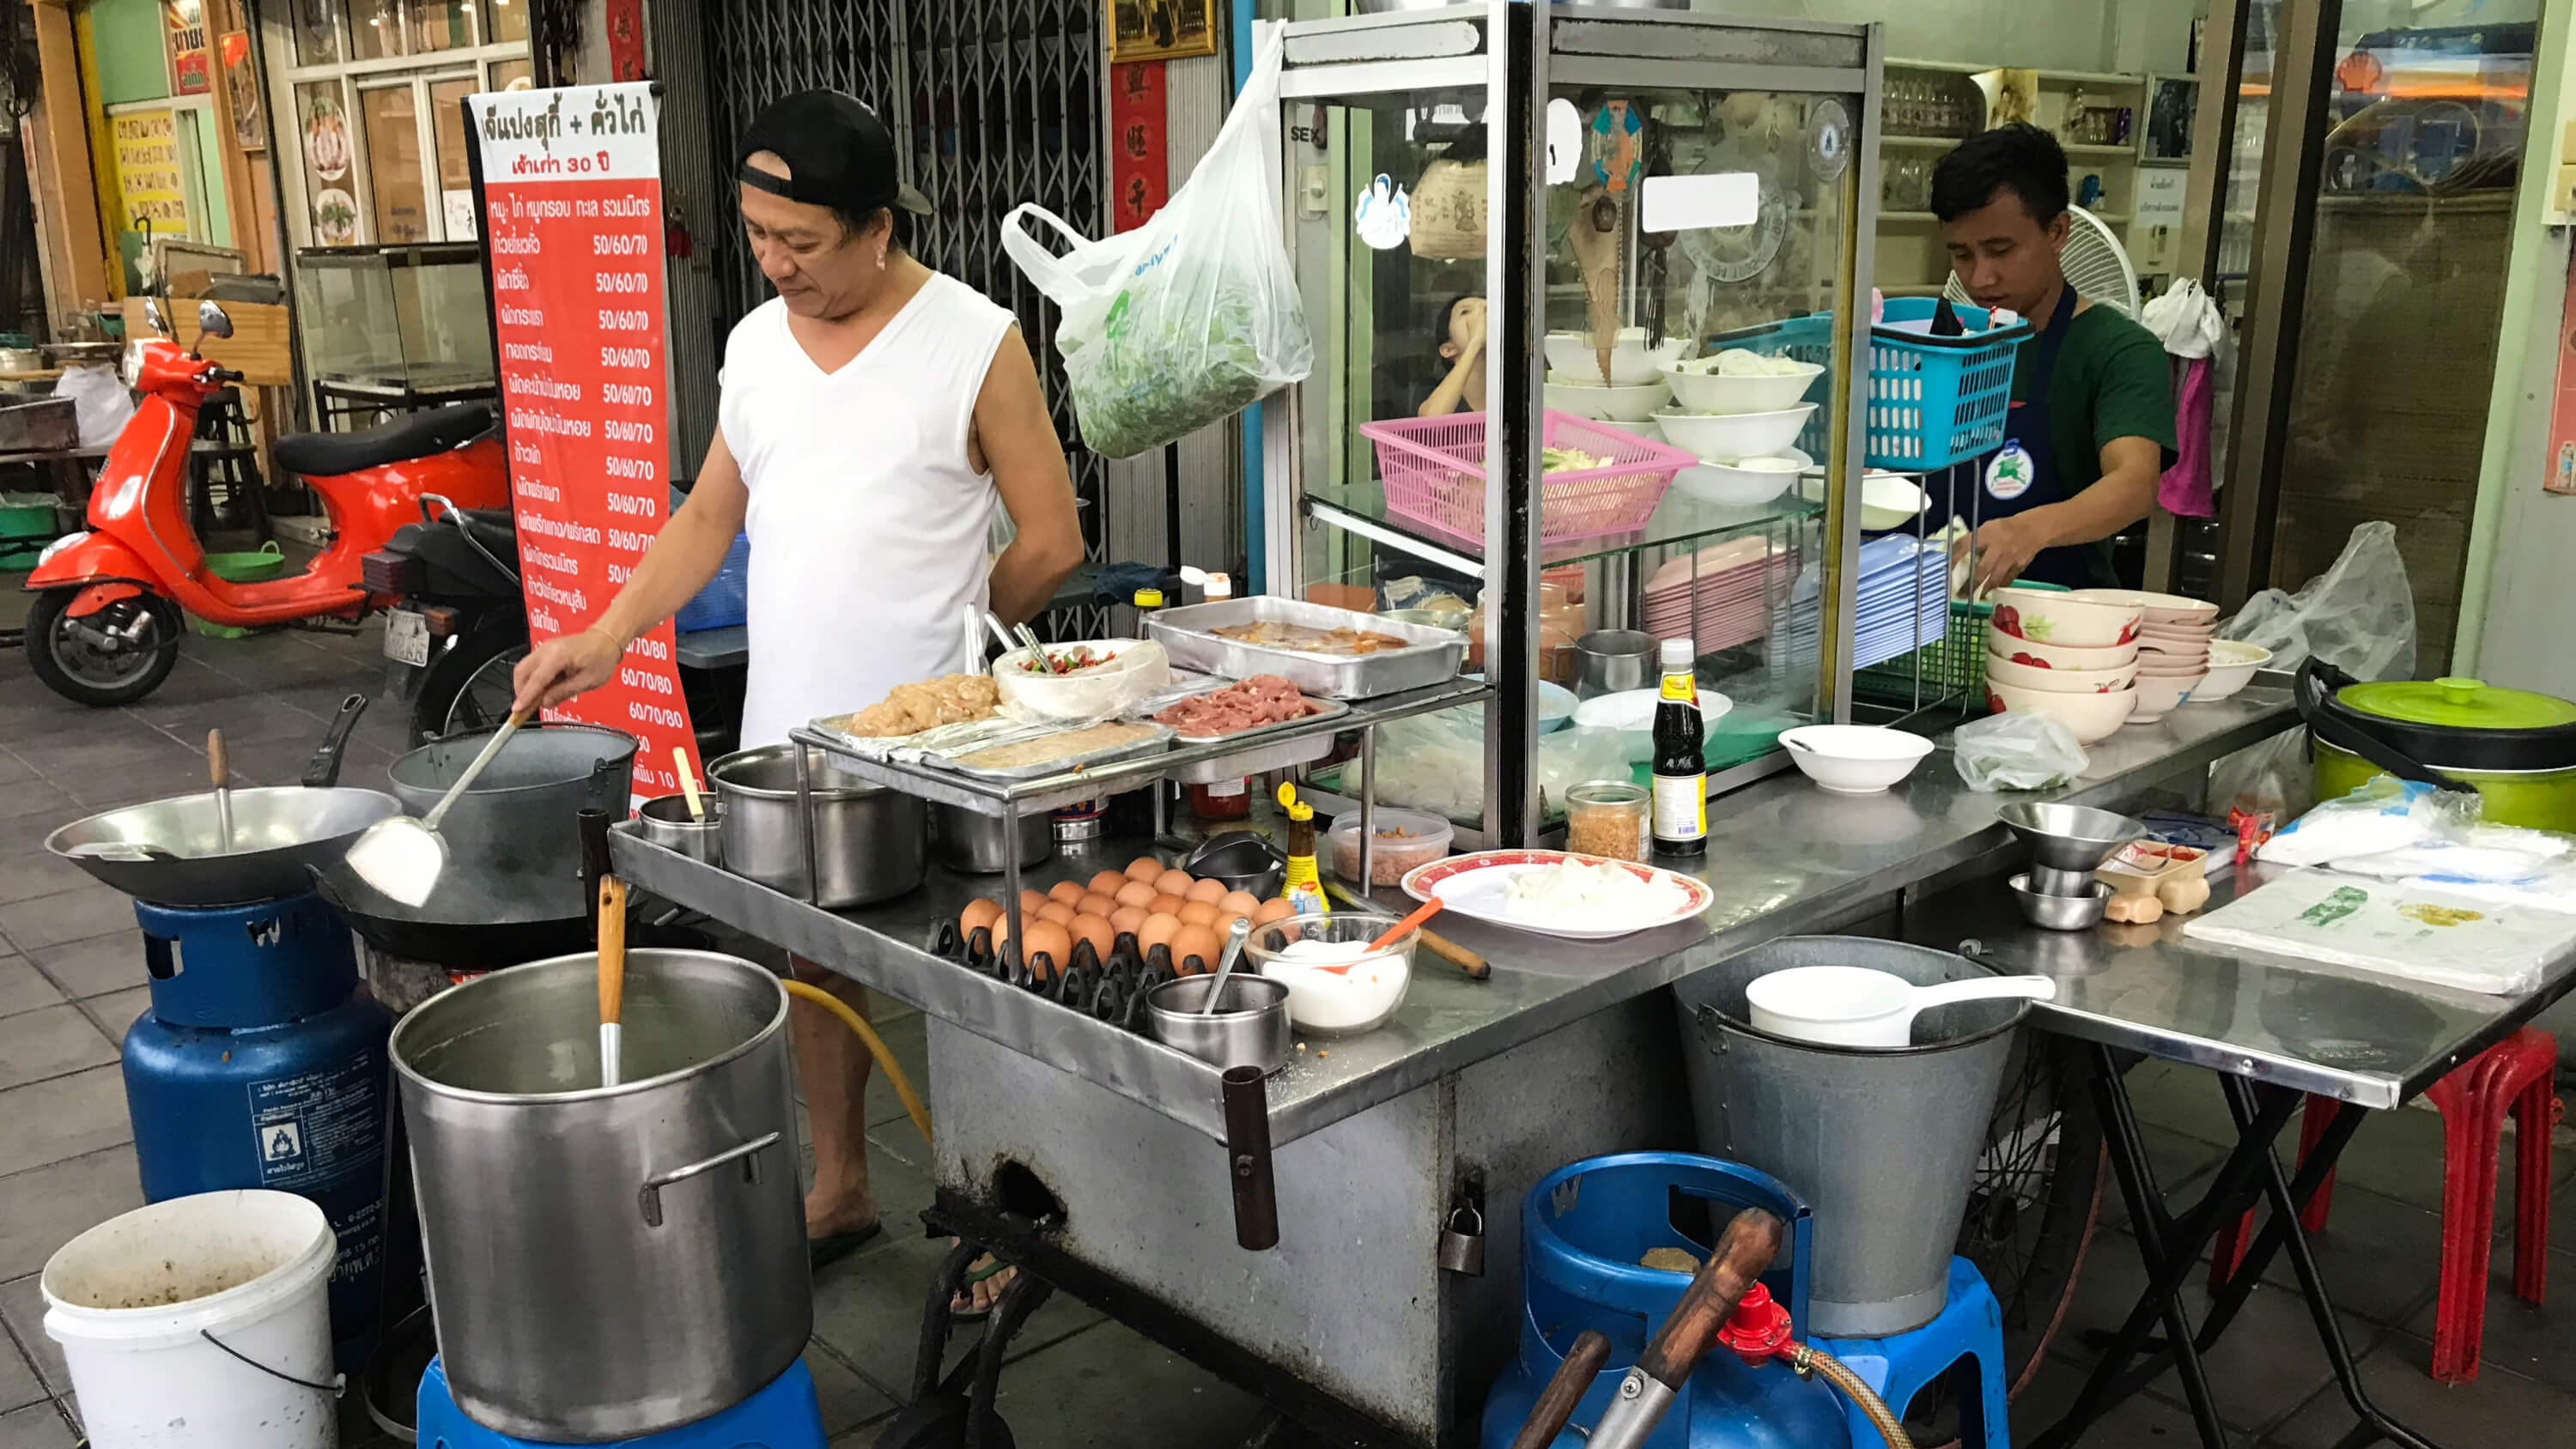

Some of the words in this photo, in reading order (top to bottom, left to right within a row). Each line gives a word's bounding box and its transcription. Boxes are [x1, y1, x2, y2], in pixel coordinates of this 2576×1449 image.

[569, 115, 582, 135] +
[592, 90, 646, 136] คั่วไก่
[512, 154, 561, 174] เจ้าเก่า
[568, 158, 591, 173] 30
[597, 150, 611, 173] ปี
[509, 192, 524, 218] ไก่
[526, 199, 571, 224] หมูกรอบ
[576, 200, 598, 217] ทะเล
[604, 195, 650, 217] รวมมิตร
[593, 234, 647, 255] 50/60/70
[596, 273, 648, 294] 50/60/70
[598, 310, 648, 330] 50/60/70
[601, 347, 650, 369] 50/60/70
[603, 384, 652, 406] 50/60/70
[605, 420, 653, 444] 50/60/70
[606, 456, 653, 481] 50/60/70
[607, 492, 655, 518] 50/60/70
[622, 667, 672, 694] 60/70/80
[629, 701, 683, 729] 60/70/80
[658, 770, 675, 789] 10
